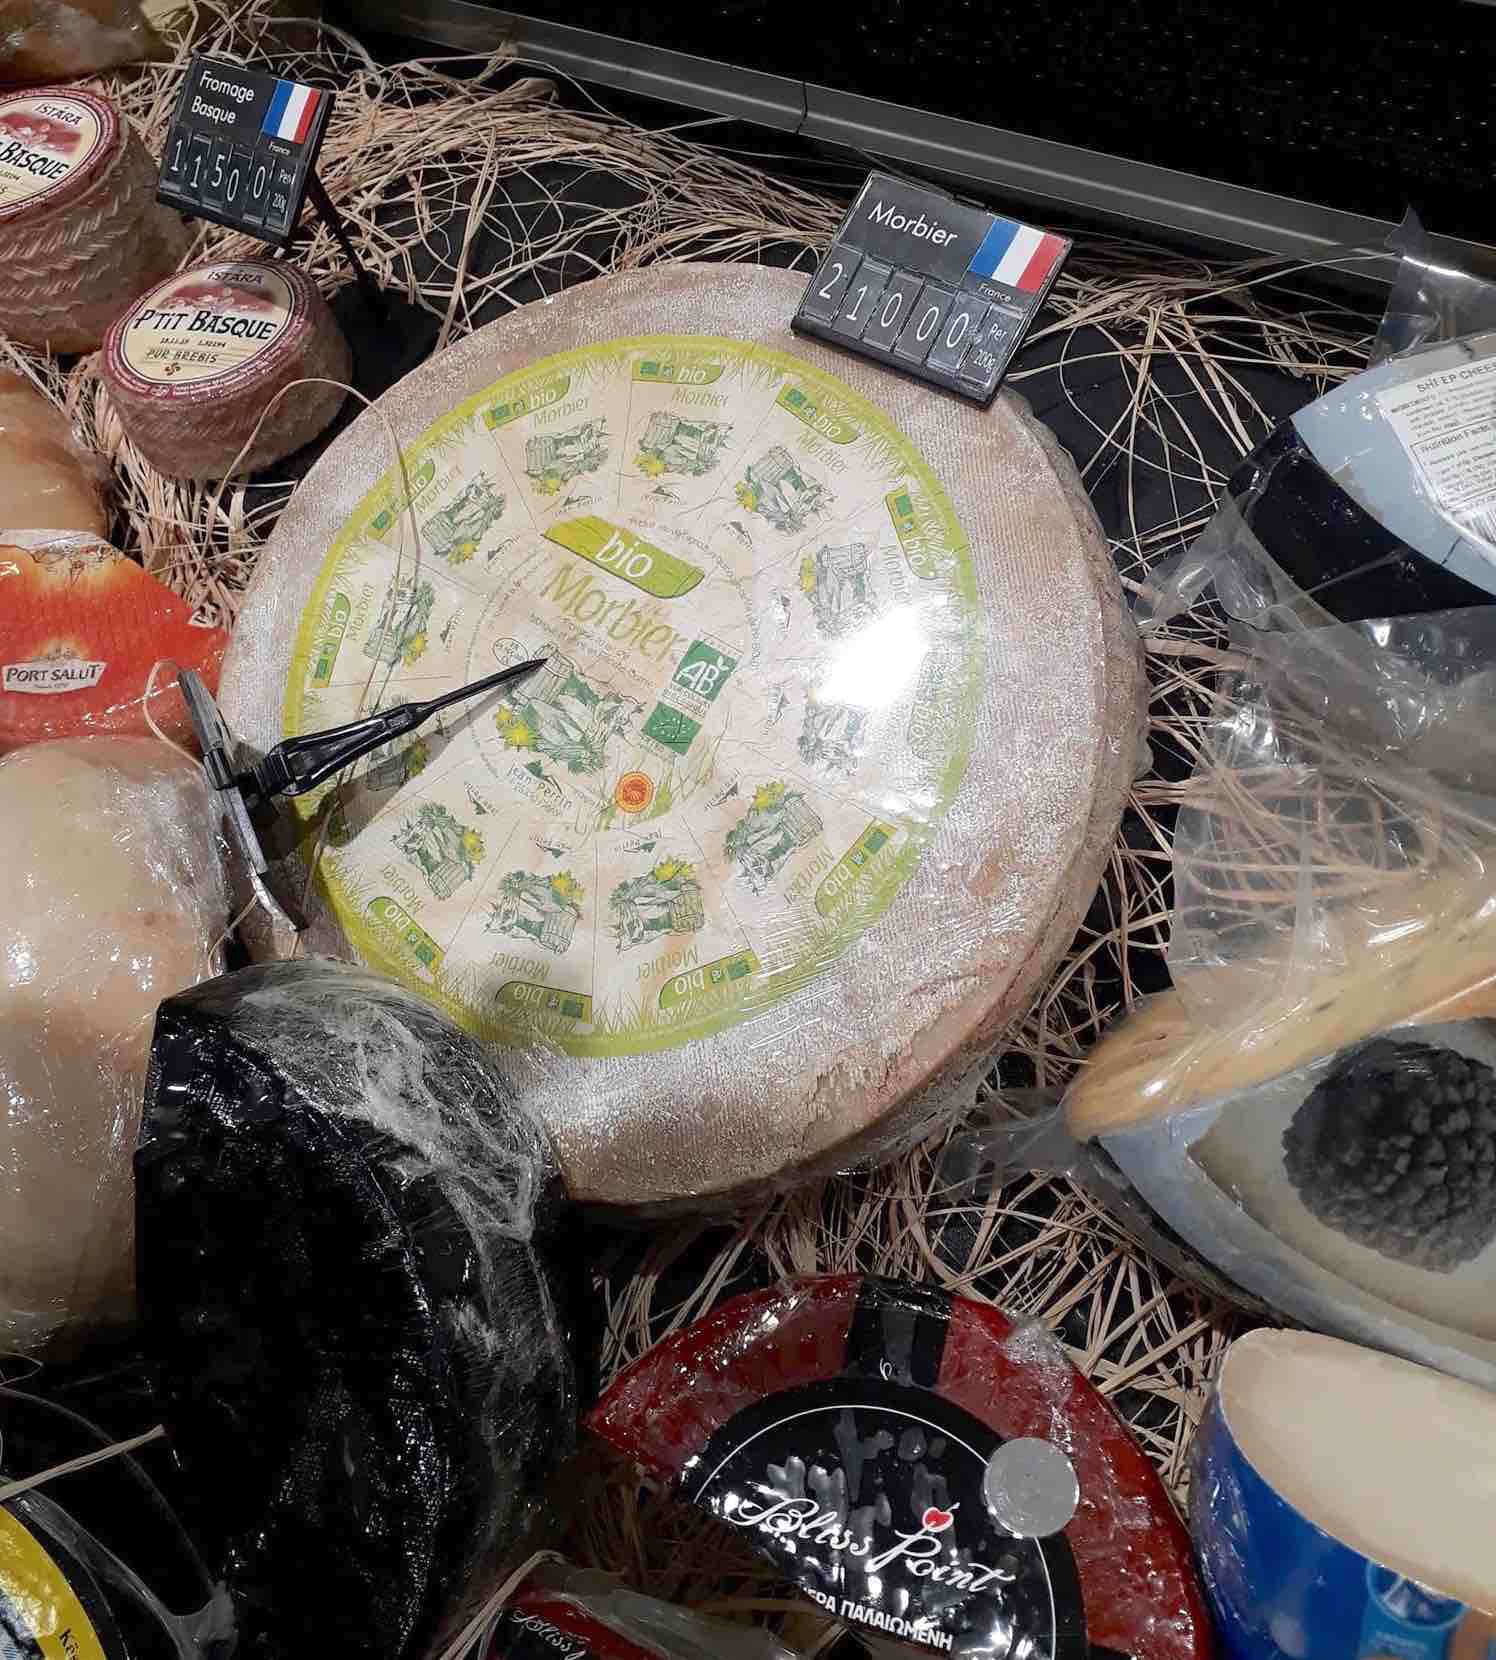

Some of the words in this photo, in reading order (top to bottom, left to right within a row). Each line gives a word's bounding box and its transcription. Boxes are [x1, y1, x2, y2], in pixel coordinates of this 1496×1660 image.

[200, 70, 254, 103] Fromage
[191, 96, 236, 124] Basque
[268, 141, 291, 156] France
[868, 201, 958, 247] Morbier
[978, 282, 1012, 303] France
[189, 310, 277, 340] BASQUE
[990, 322, 1008, 342] Per
[973, 348, 996, 373] 200g
[678, 366, 705, 383] bio
[529, 384, 558, 405] bio
[814, 413, 841, 438] bio
[597, 530, 654, 578] bio
[327, 609, 346, 638] bio
[542, 561, 689, 662] Morbier
[6, 667, 48, 682] PORT
[50, 664, 102, 681] SALUT
[676, 660, 721, 696] AB
[824, 862, 853, 897] bio
[384, 903, 411, 930] bio
[513, 983, 544, 1004] bio
[673, 970, 705, 994] bio
[725, 1497, 872, 1557] Bliss
[865, 1510, 1017, 1592] Point
